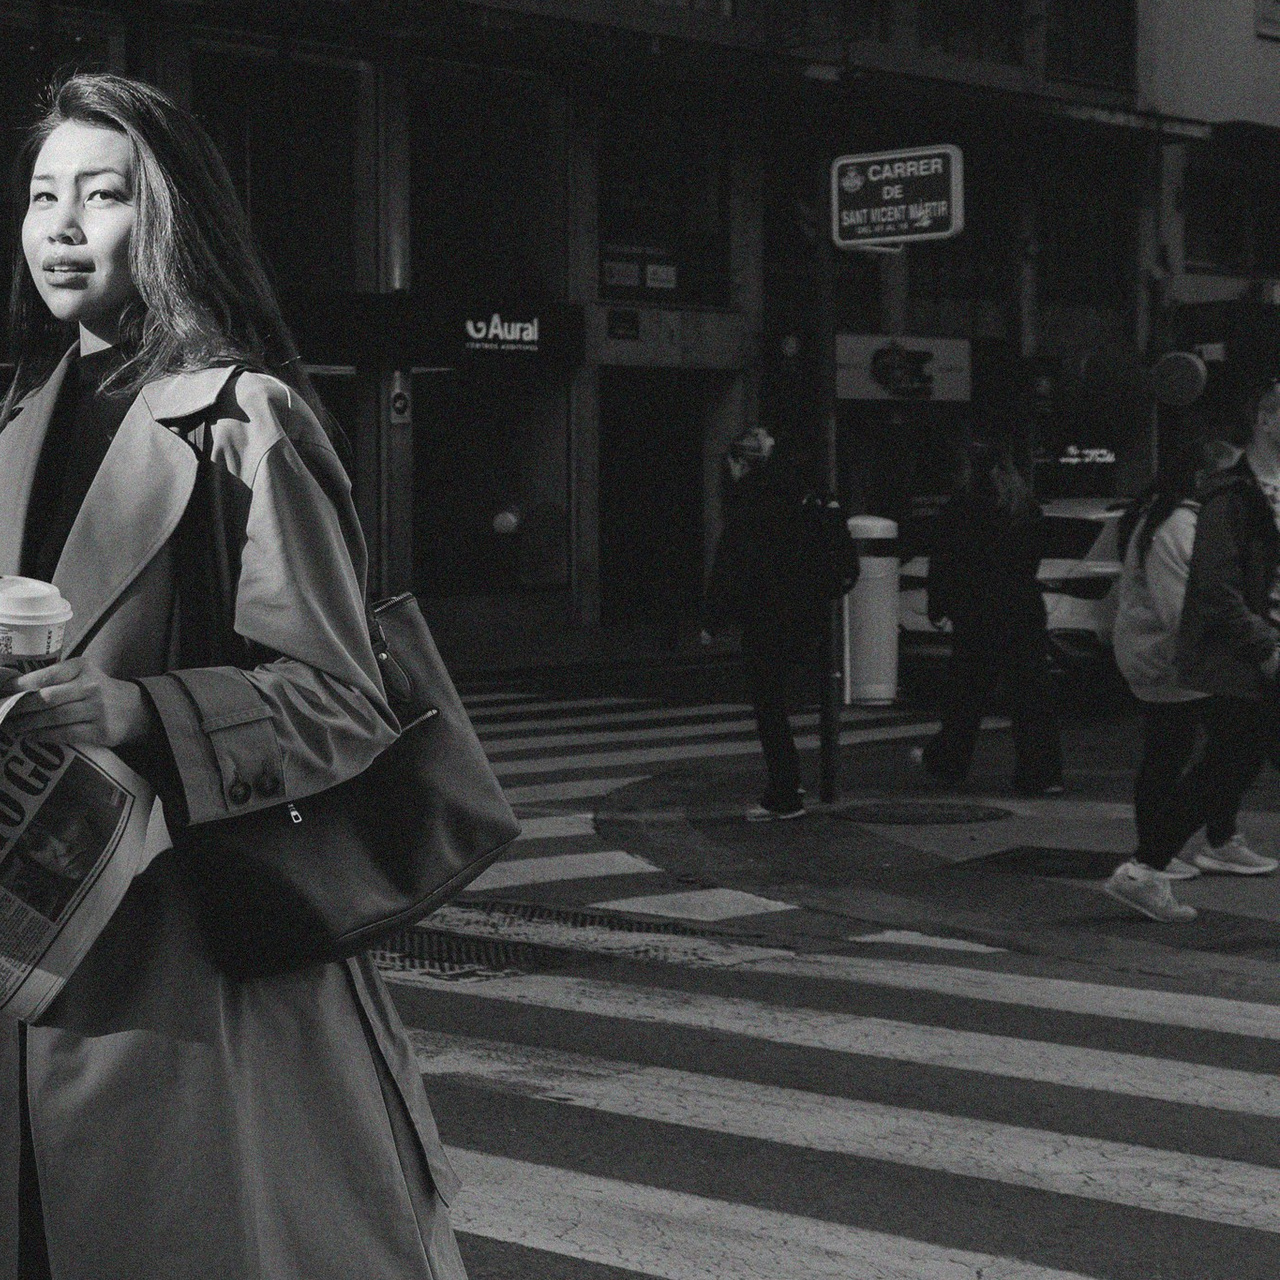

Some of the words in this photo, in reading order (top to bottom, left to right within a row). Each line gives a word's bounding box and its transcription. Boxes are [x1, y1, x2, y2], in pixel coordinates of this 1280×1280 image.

[867, 158, 943, 181] CARRER
[882, 185, 904, 199] DE
[841, 208, 869, 227] SANT
[870, 204, 907, 223] VICENT
[487, 312, 539, 341] Aural
[3, 734, 67, 797] GO
